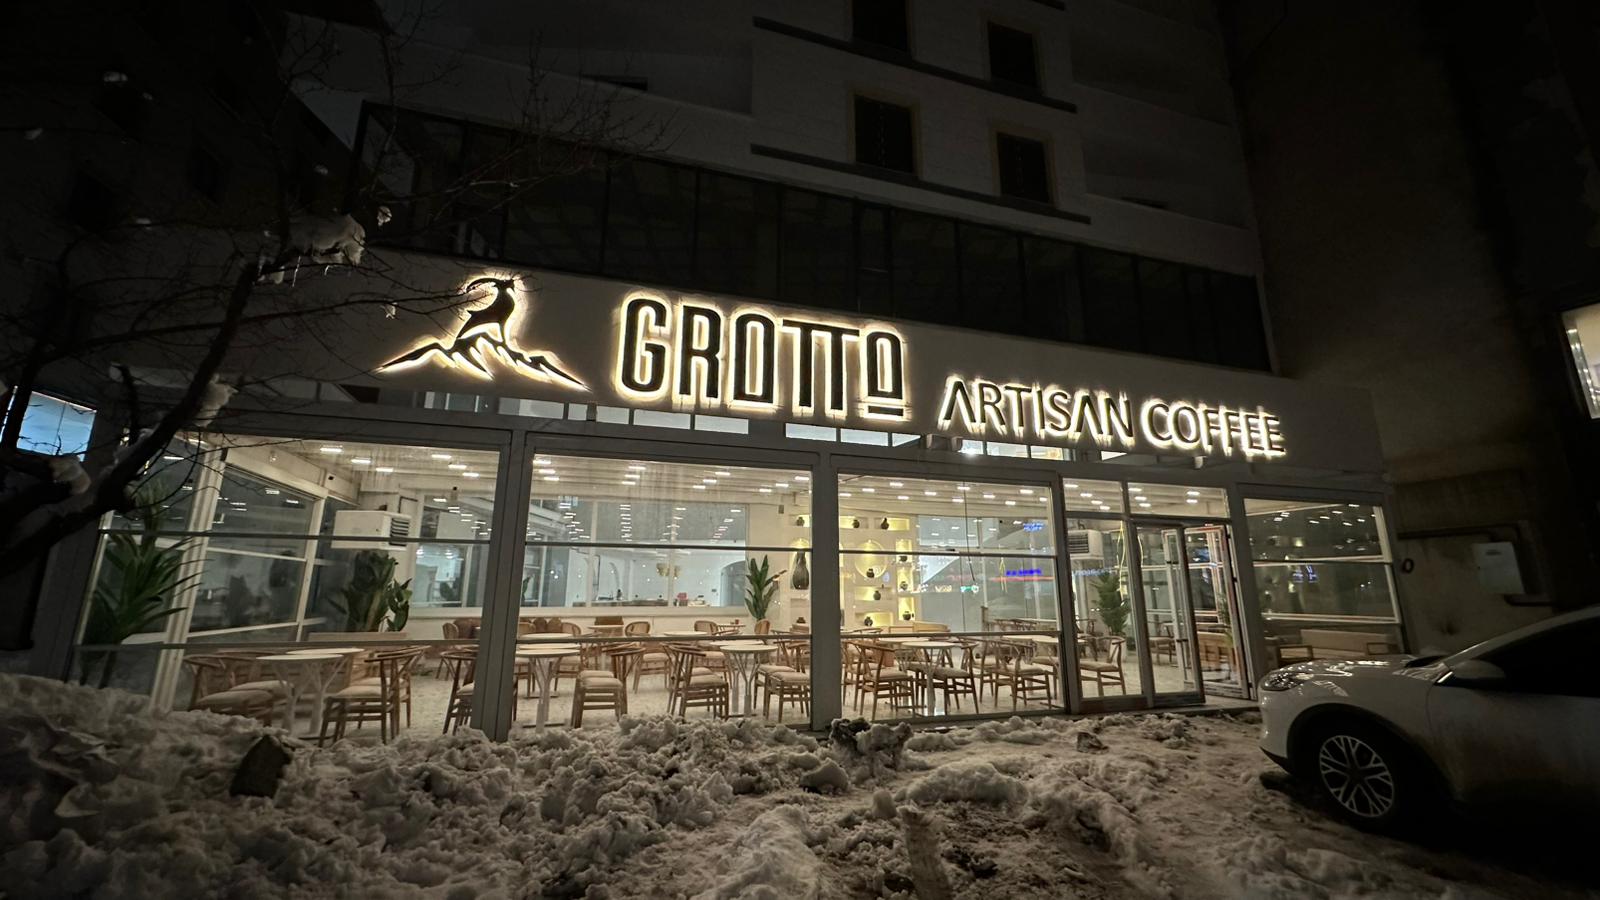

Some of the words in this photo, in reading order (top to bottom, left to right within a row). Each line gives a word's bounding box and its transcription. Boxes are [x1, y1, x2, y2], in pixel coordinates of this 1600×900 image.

[620, 296, 907, 421] GROTTO
[941, 377, 1135, 442] ARTISAN
[1142, 399, 1287, 456] COFFEE
